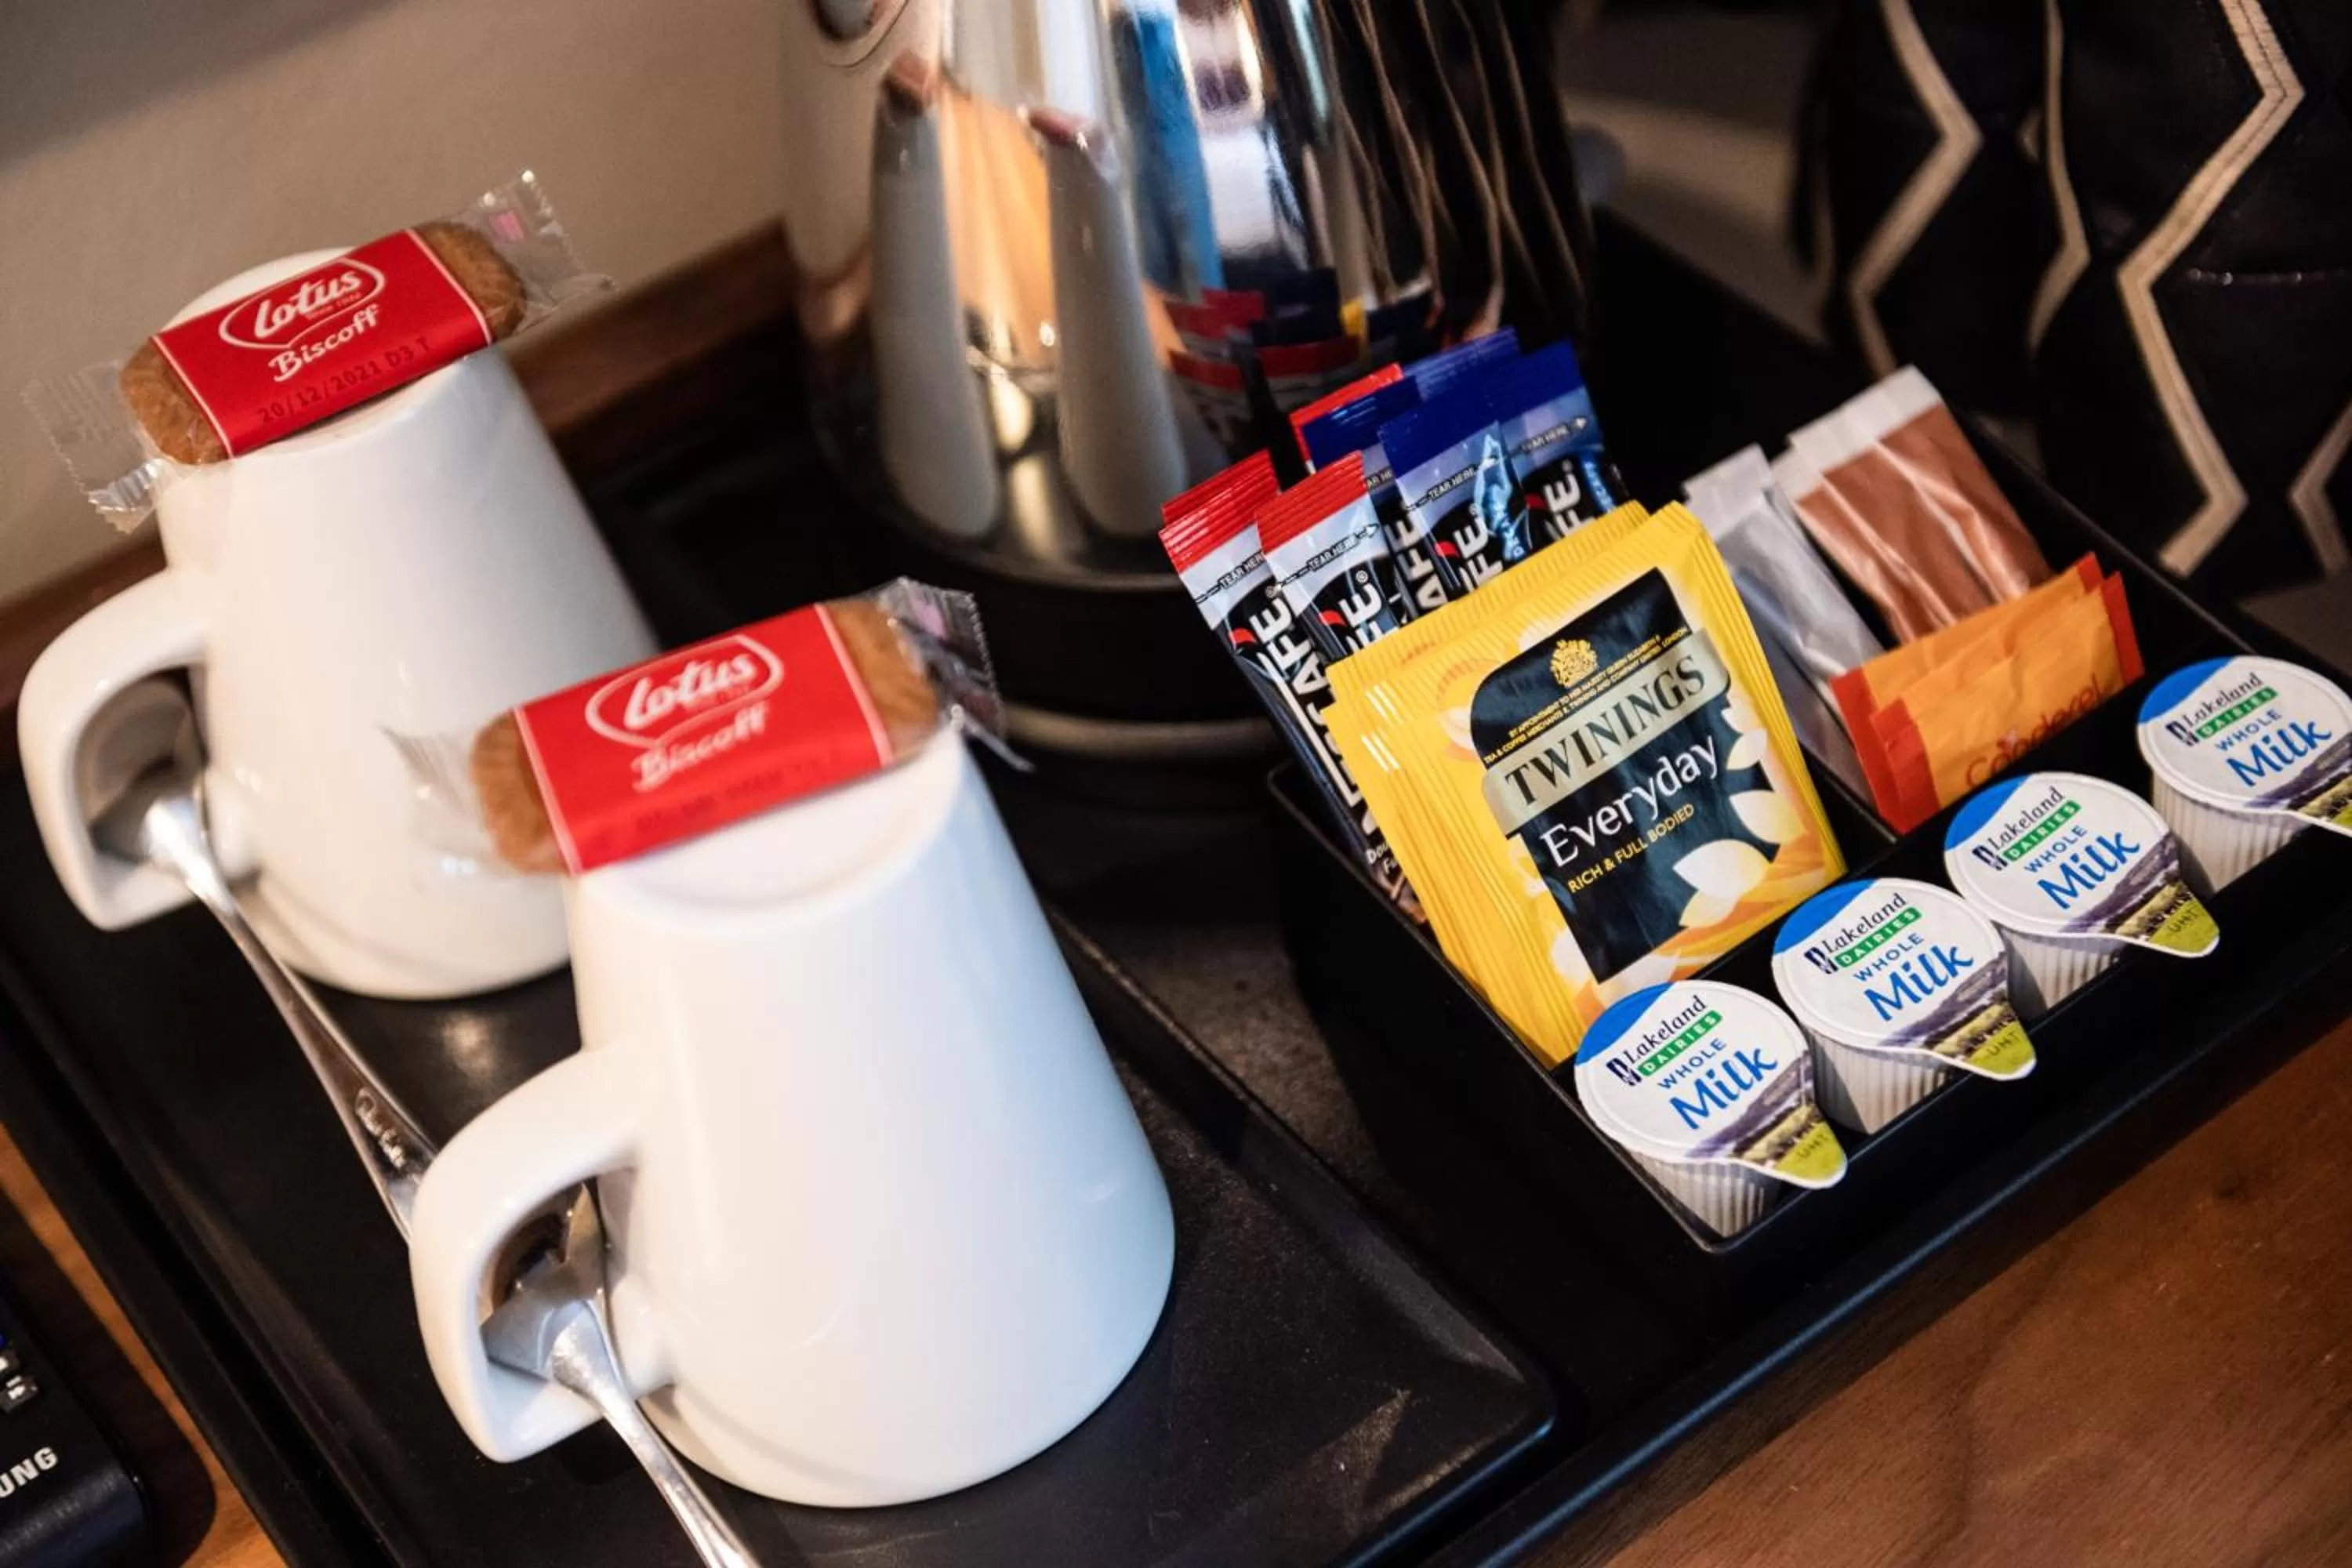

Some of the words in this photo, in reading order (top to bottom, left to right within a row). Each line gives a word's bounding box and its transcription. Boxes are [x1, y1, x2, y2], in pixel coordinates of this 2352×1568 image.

[253, 269, 362, 339] Lotus
[268, 303, 381, 383] Biscoff
[258, 362, 379, 424] 20/12/2021
[1428, 480, 1451, 499] TEAR
[1452, 468, 1475, 487] HERE
[1220, 567, 1245, 589] TEAR
[1308, 553, 1332, 570] TEAR
[1332, 536, 1357, 557] HERE
[622, 652, 757, 731] Lotus
[2182, 672, 2264, 728] Lakeland
[631, 703, 768, 793] Biscoff
[1504, 654, 1706, 807] TWININGS
[2215, 709, 2283, 752] WHOLE
[2226, 721, 2332, 787] Milk
[1540, 735, 1719, 869] Everyday
[1987, 786, 2064, 850] Lakeland
[2008, 803, 2078, 858] DAIRIES
[1568, 862, 1603, 894] RICH
[1604, 855, 1617, 872] &
[1616, 839, 1648, 865] FULL
[1646, 802, 1695, 843] BODIED
[2024, 826, 2088, 873] WHOLE
[2037, 832, 2140, 909] Milk
[1822, 892, 1907, 954] Lakeland
[1842, 909, 1917, 965] DAIRIES
[2167, 907, 2198, 933] UHT
[1853, 932, 1924, 982] WHOLE
[1864, 945, 1973, 1022] Milk
[1623, 994, 1708, 1064] Lakeland
[1645, 1014, 1716, 1073] DAIRIES
[1987, 1031, 2020, 1057] UHT
[1657, 1039, 1727, 1090] WHOLE
[1669, 1048, 1778, 1130] Milk
[1798, 1133, 1828, 1160] UHT
